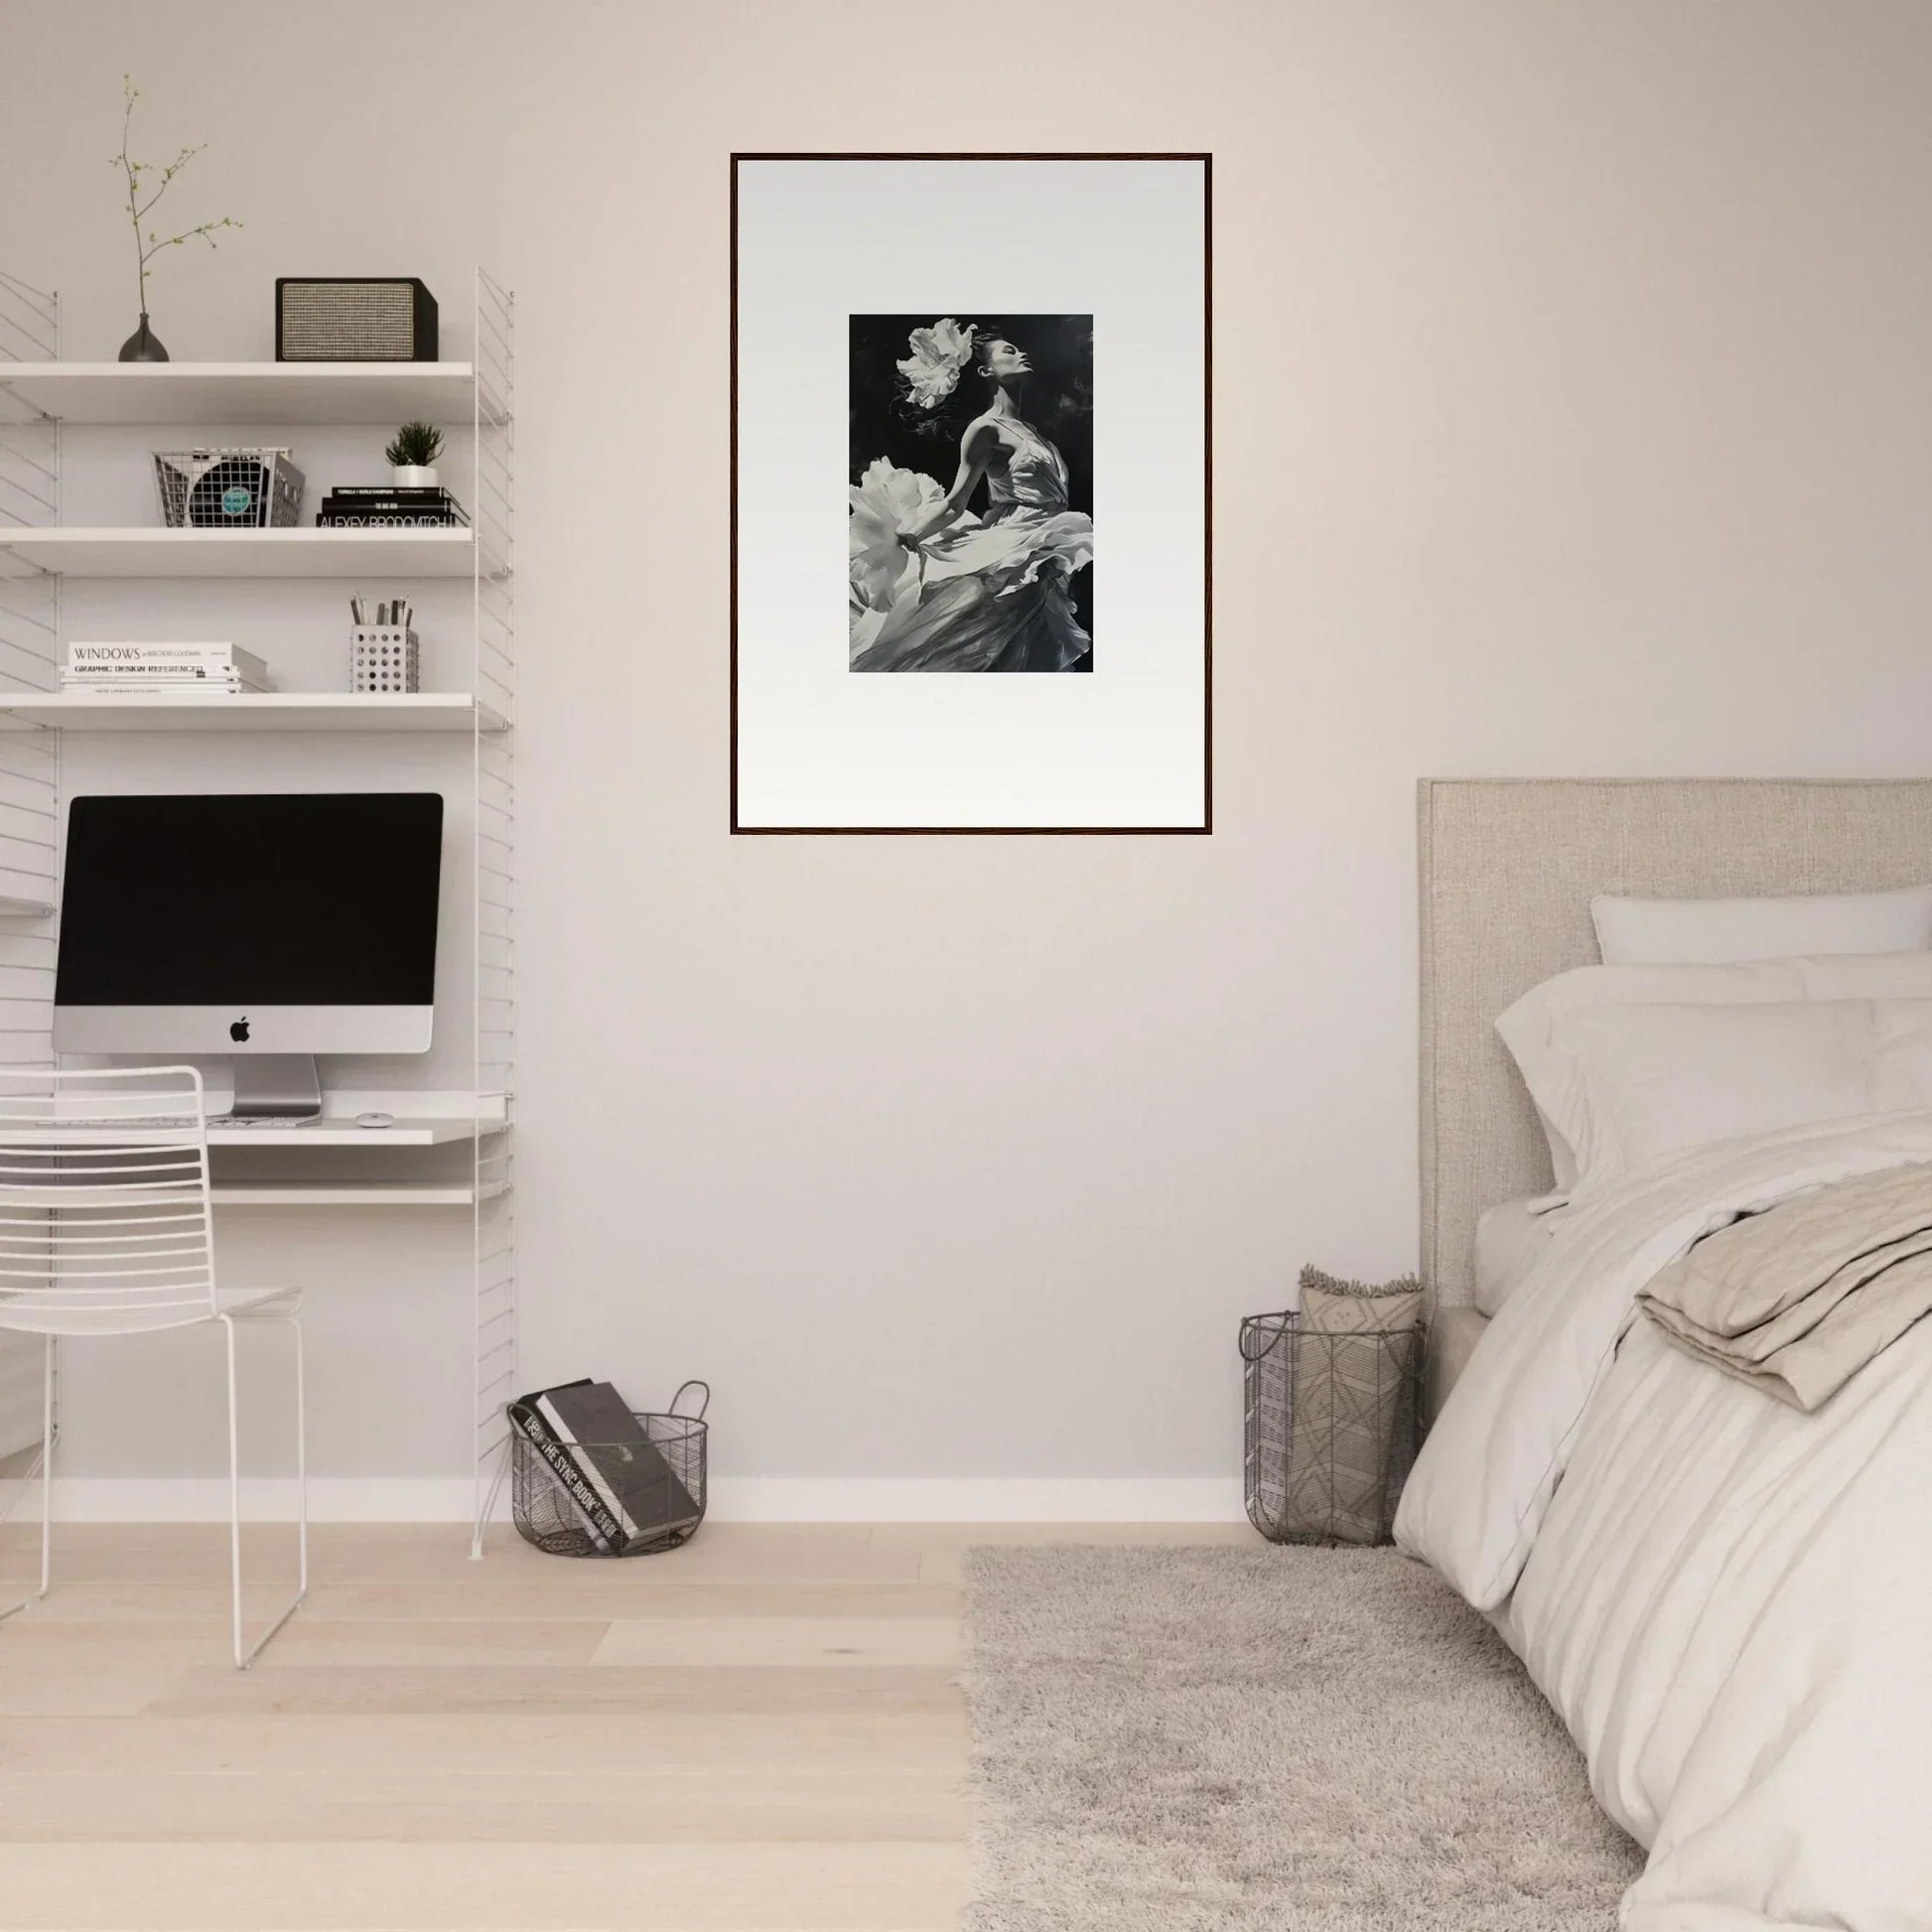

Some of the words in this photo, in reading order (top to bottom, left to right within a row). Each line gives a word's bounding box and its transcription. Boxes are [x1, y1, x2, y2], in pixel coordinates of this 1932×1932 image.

[74, 647, 141, 659] WINDOWS
[554, 1455, 579, 1485] SYNC
[572, 1480, 598, 1512] BOOK
